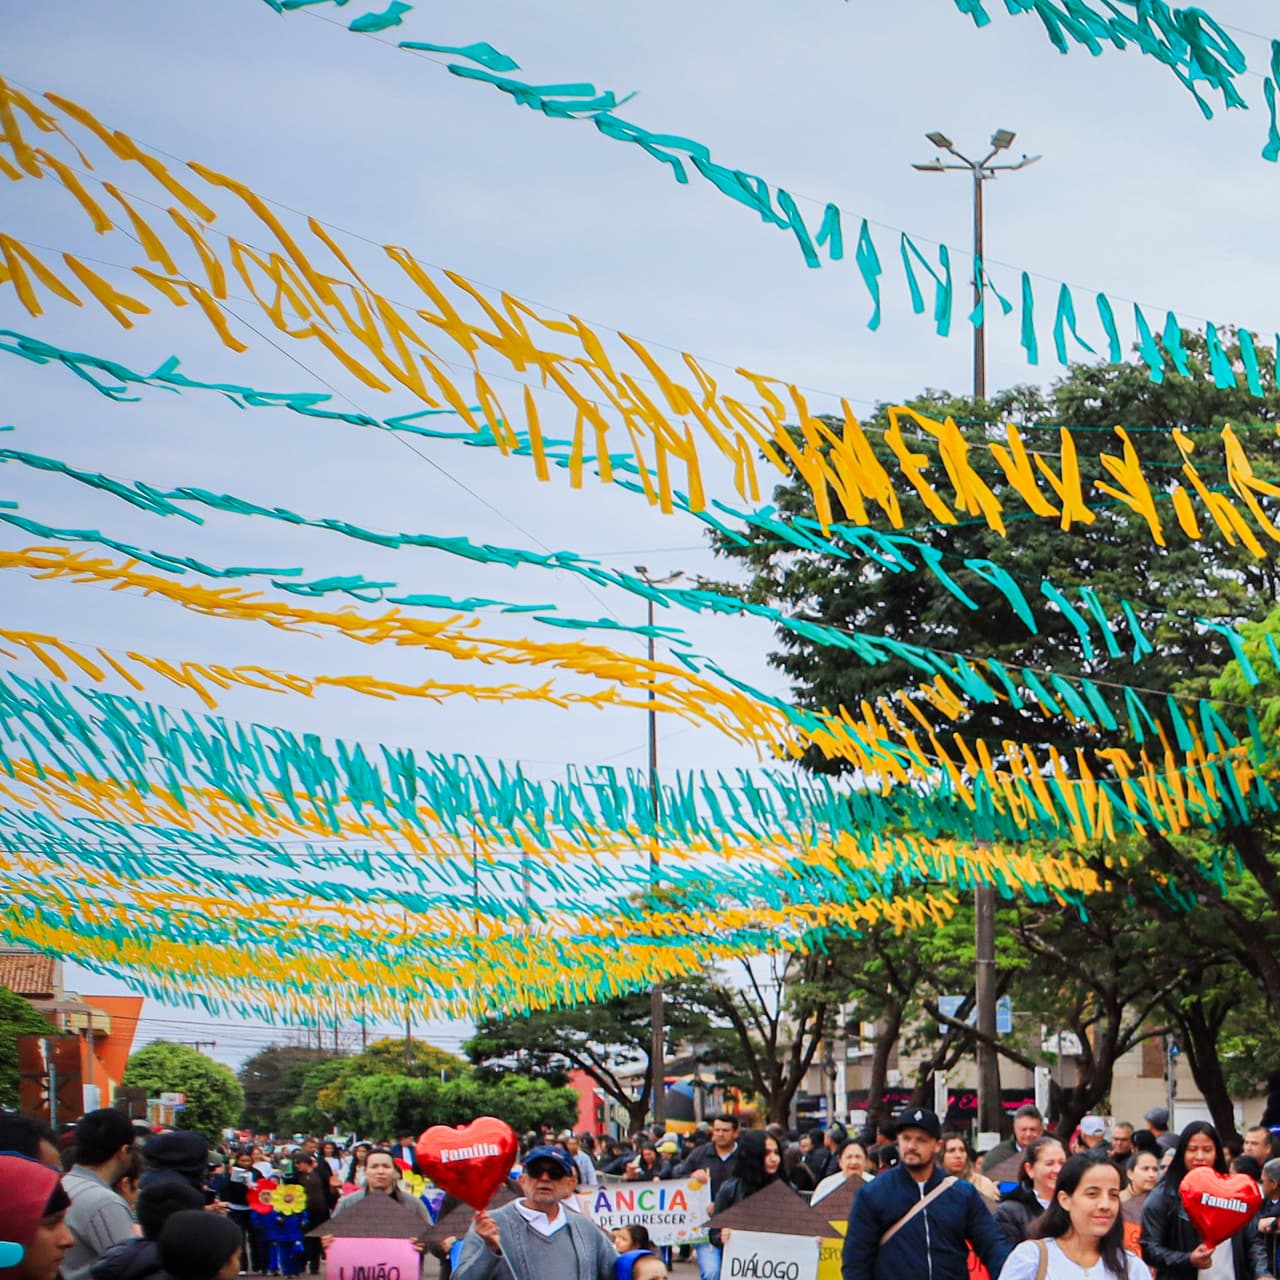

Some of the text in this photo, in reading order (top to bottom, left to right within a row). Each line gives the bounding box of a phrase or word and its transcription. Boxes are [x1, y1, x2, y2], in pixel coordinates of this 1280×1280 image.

[579, 1185, 687, 1213] ÂNCIA
[600, 1214, 686, 1226] DE FLORESCER
[731, 1251, 799, 1280] DIÁLOGO
